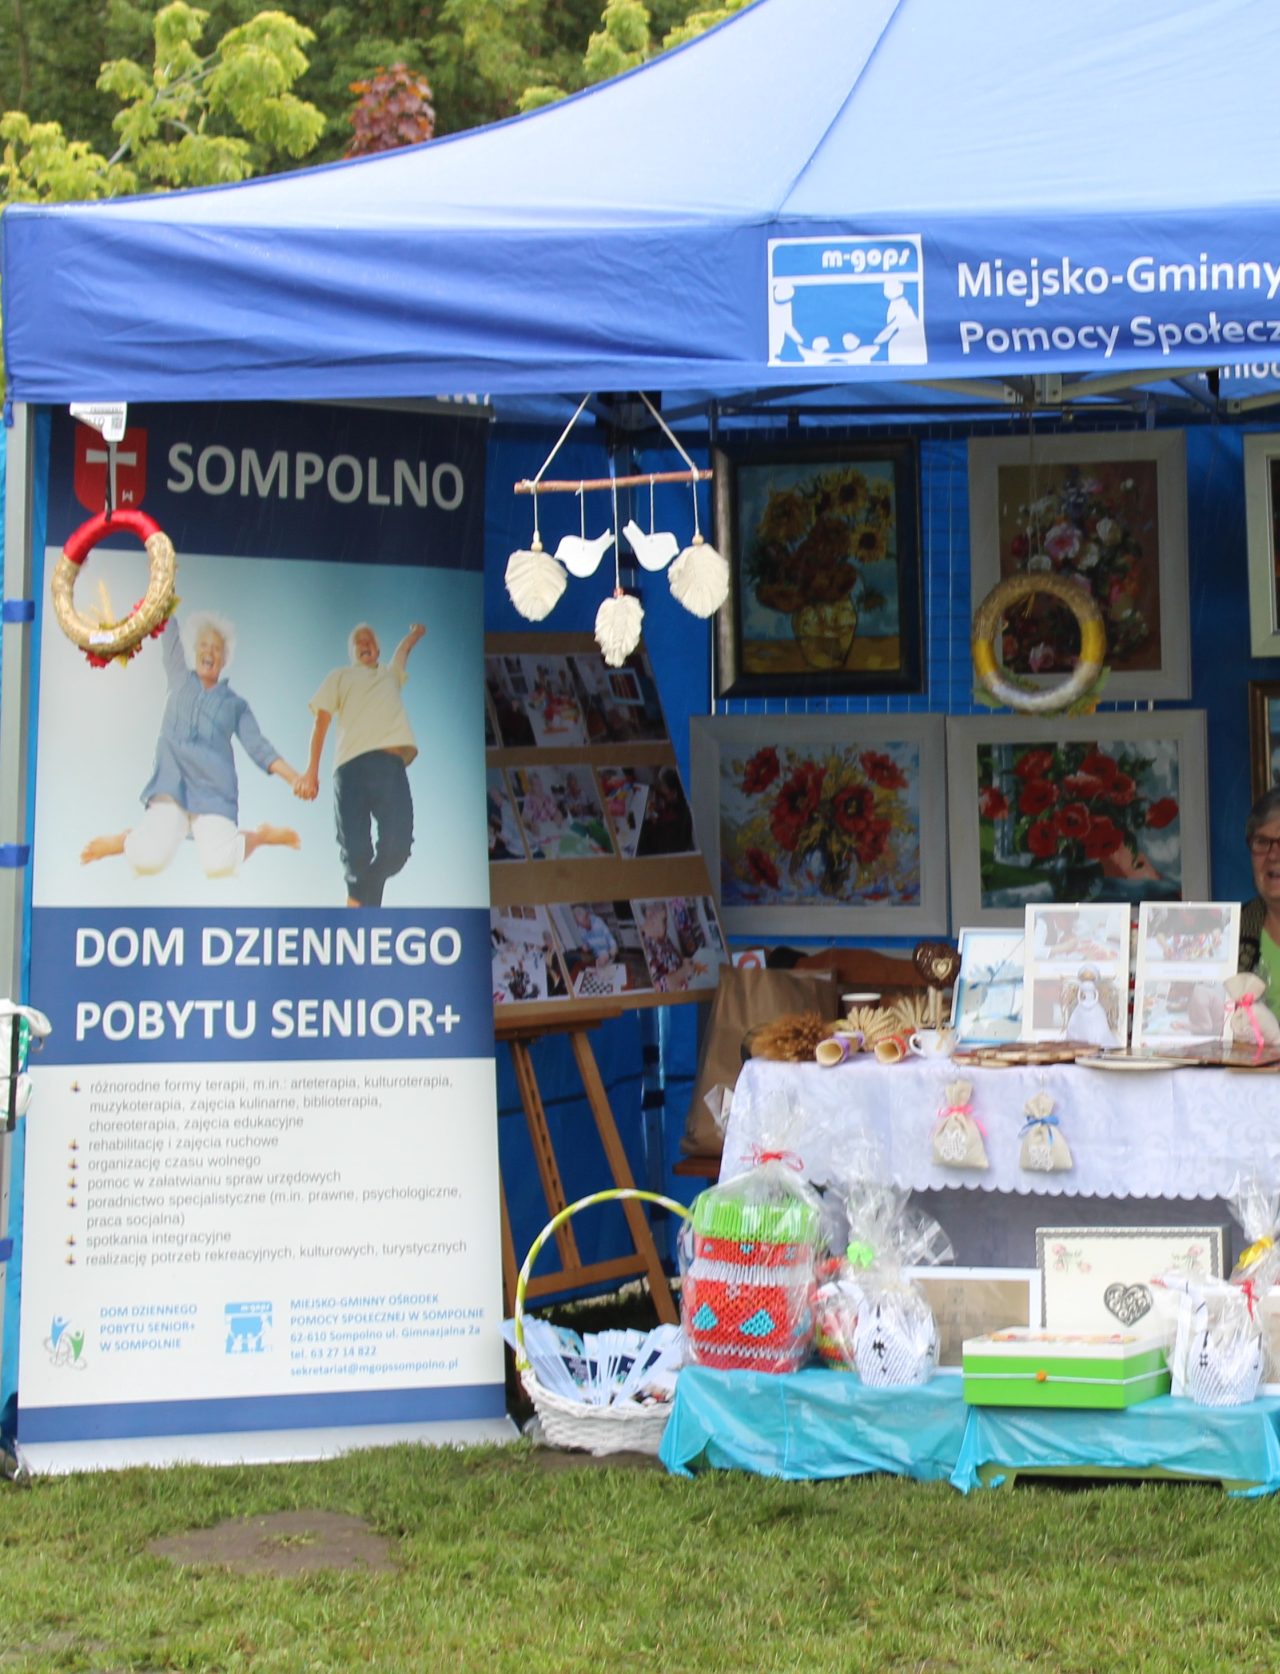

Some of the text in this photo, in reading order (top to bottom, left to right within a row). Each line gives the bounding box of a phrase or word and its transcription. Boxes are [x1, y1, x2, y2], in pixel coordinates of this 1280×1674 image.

[821, 247, 910, 273] m-gops
[959, 321, 1119, 358] Pomocy
[166, 442, 465, 511] SOMPOLNO
[75, 926, 462, 968] DOM DZIENNEGO
[75, 998, 461, 1041] POBYTU SENIOR+
[90, 1079, 160, 1094] różnorodne
[164, 1078, 201, 1095] formy
[205, 1078, 249, 1094] terapii,
[290, 1075, 360, 1091] arteterapia,
[364, 1073, 453, 1091] kulturoterapia,
[89, 1093, 382, 1116] muzykoterapia, zajęcia kulinarne, biblioterapia,
[89, 1115, 304, 1134] choreoterapia, zajęcia edukacyjne
[88, 1135, 279, 1153] rehabilitację i zajęcia ruchowe
[88, 1154, 261, 1173] organizację czasu wolnego
[87, 1170, 341, 1192] pomoc w załatwianiu spraw urzędowych
[87, 1194, 165, 1211] poradnictwo
[169, 1192, 266, 1208] specjalistyczne
[308, 1190, 358, 1204] prawne,
[362, 1185, 462, 1203] psychologiczne,
[86, 1212, 185, 1229] praca socjalna)
[86, 1230, 232, 1248] spotkania integracyjne
[86, 1239, 467, 1268] realizację potrzeb rekreacyjnych, kulturowych, turystycznych
[388, 1292, 439, 1305] OŚRODEK
[100, 1304, 198, 1318] DOM DZIENNEGO
[290, 1308, 485, 1326] POMOCY SPOŁECZNEJ W SOMPOLNIE
[100, 1323, 145, 1335] POBYTU
[329, 1328, 382, 1342] Sompolno
[385, 1327, 398, 1339] ul.
[402, 1324, 465, 1339] Gimnazjalna
[468, 1324, 481, 1335] 2a
[99, 1338, 182, 1352] W SOMPOLNIE
